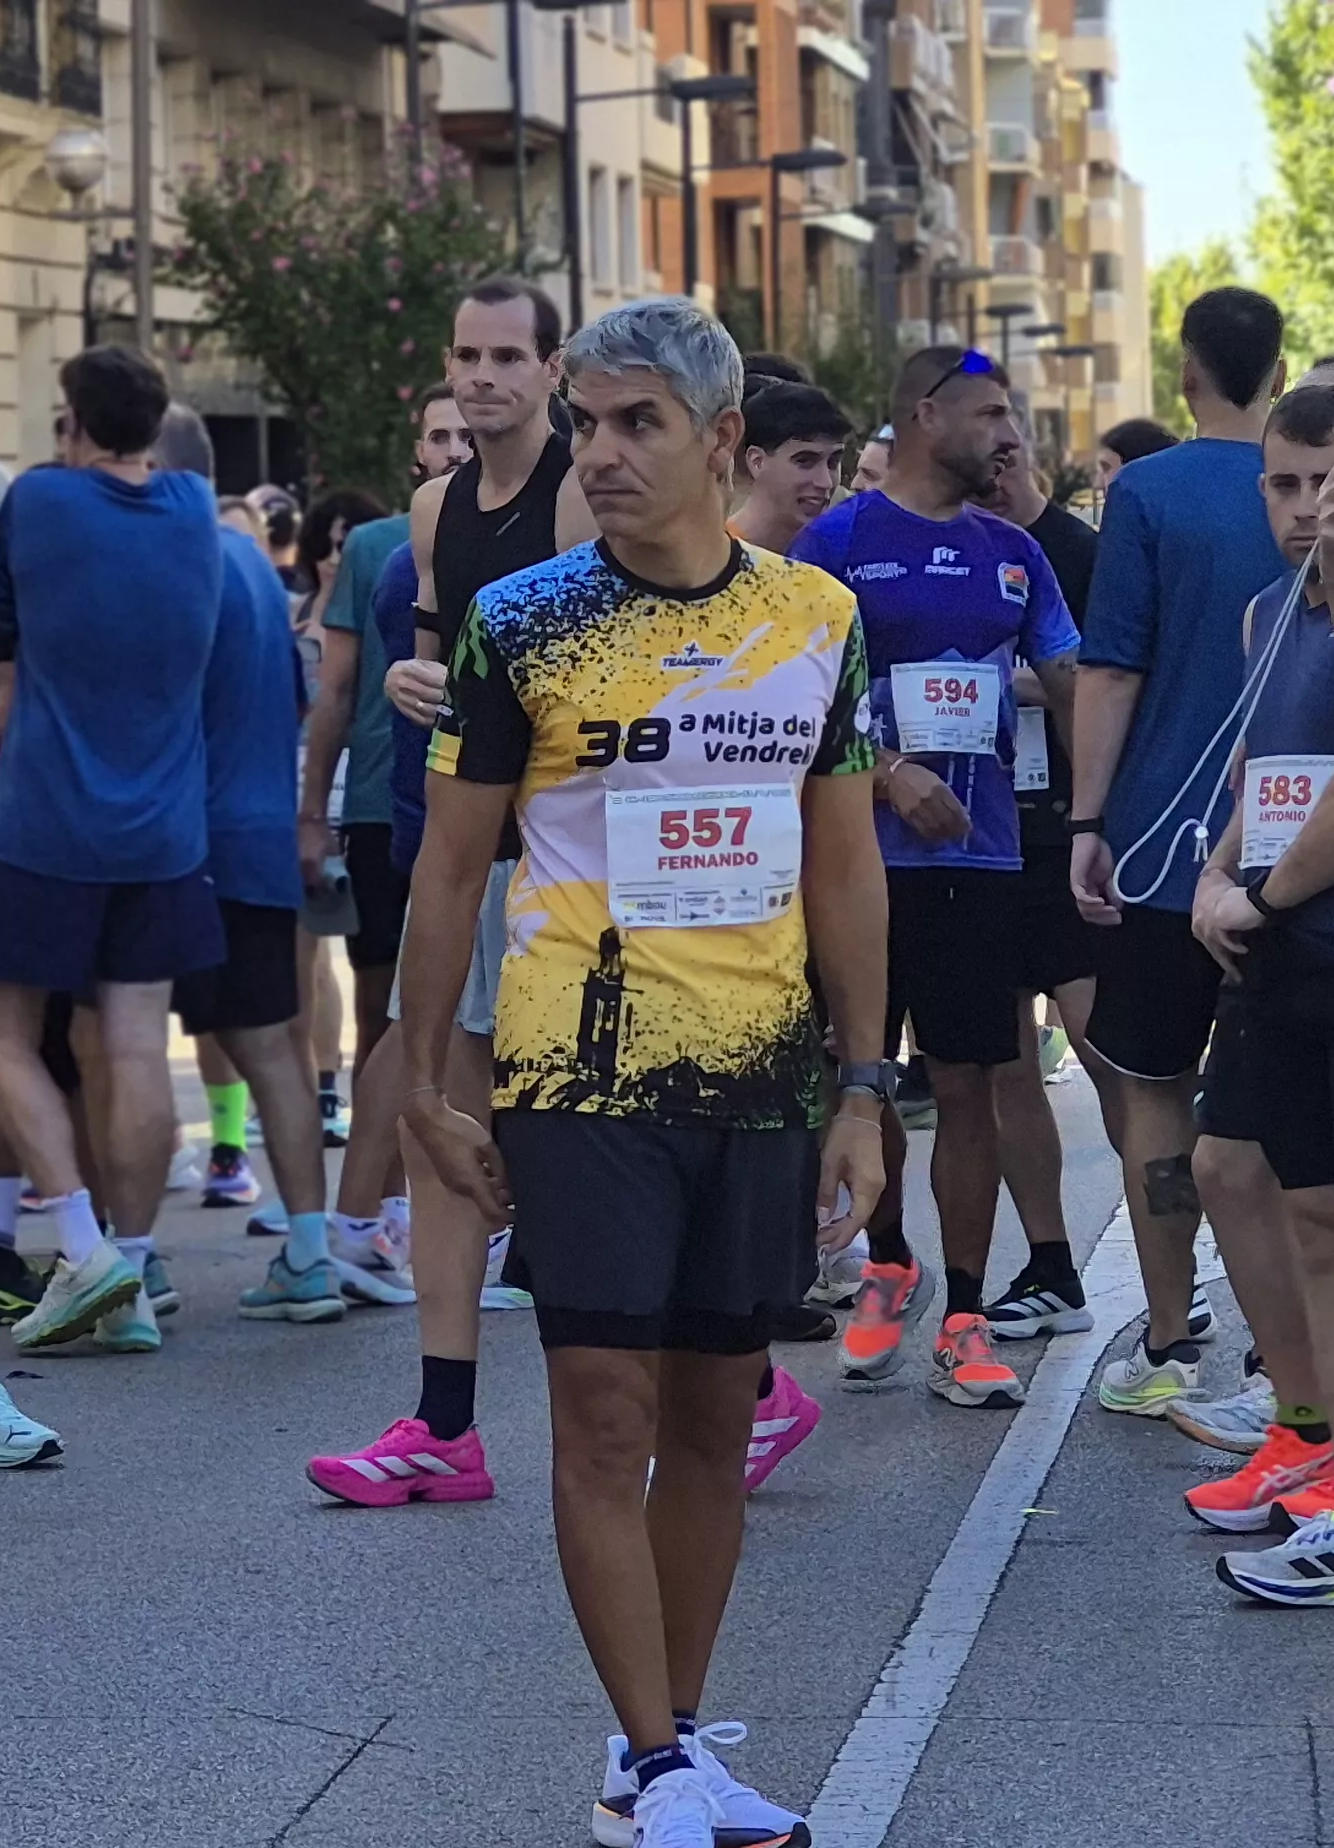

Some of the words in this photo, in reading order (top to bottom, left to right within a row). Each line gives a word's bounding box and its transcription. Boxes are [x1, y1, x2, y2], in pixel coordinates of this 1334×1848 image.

[923, 678, 979, 704] 594
[702, 710, 775, 739] Mitja
[783, 714, 816, 738] del
[1258, 775, 1312, 806] 583
[659, 806, 752, 850] 557
[1258, 810, 1306, 823] ANTONIO
[658, 851, 759, 871] FERNANDO
